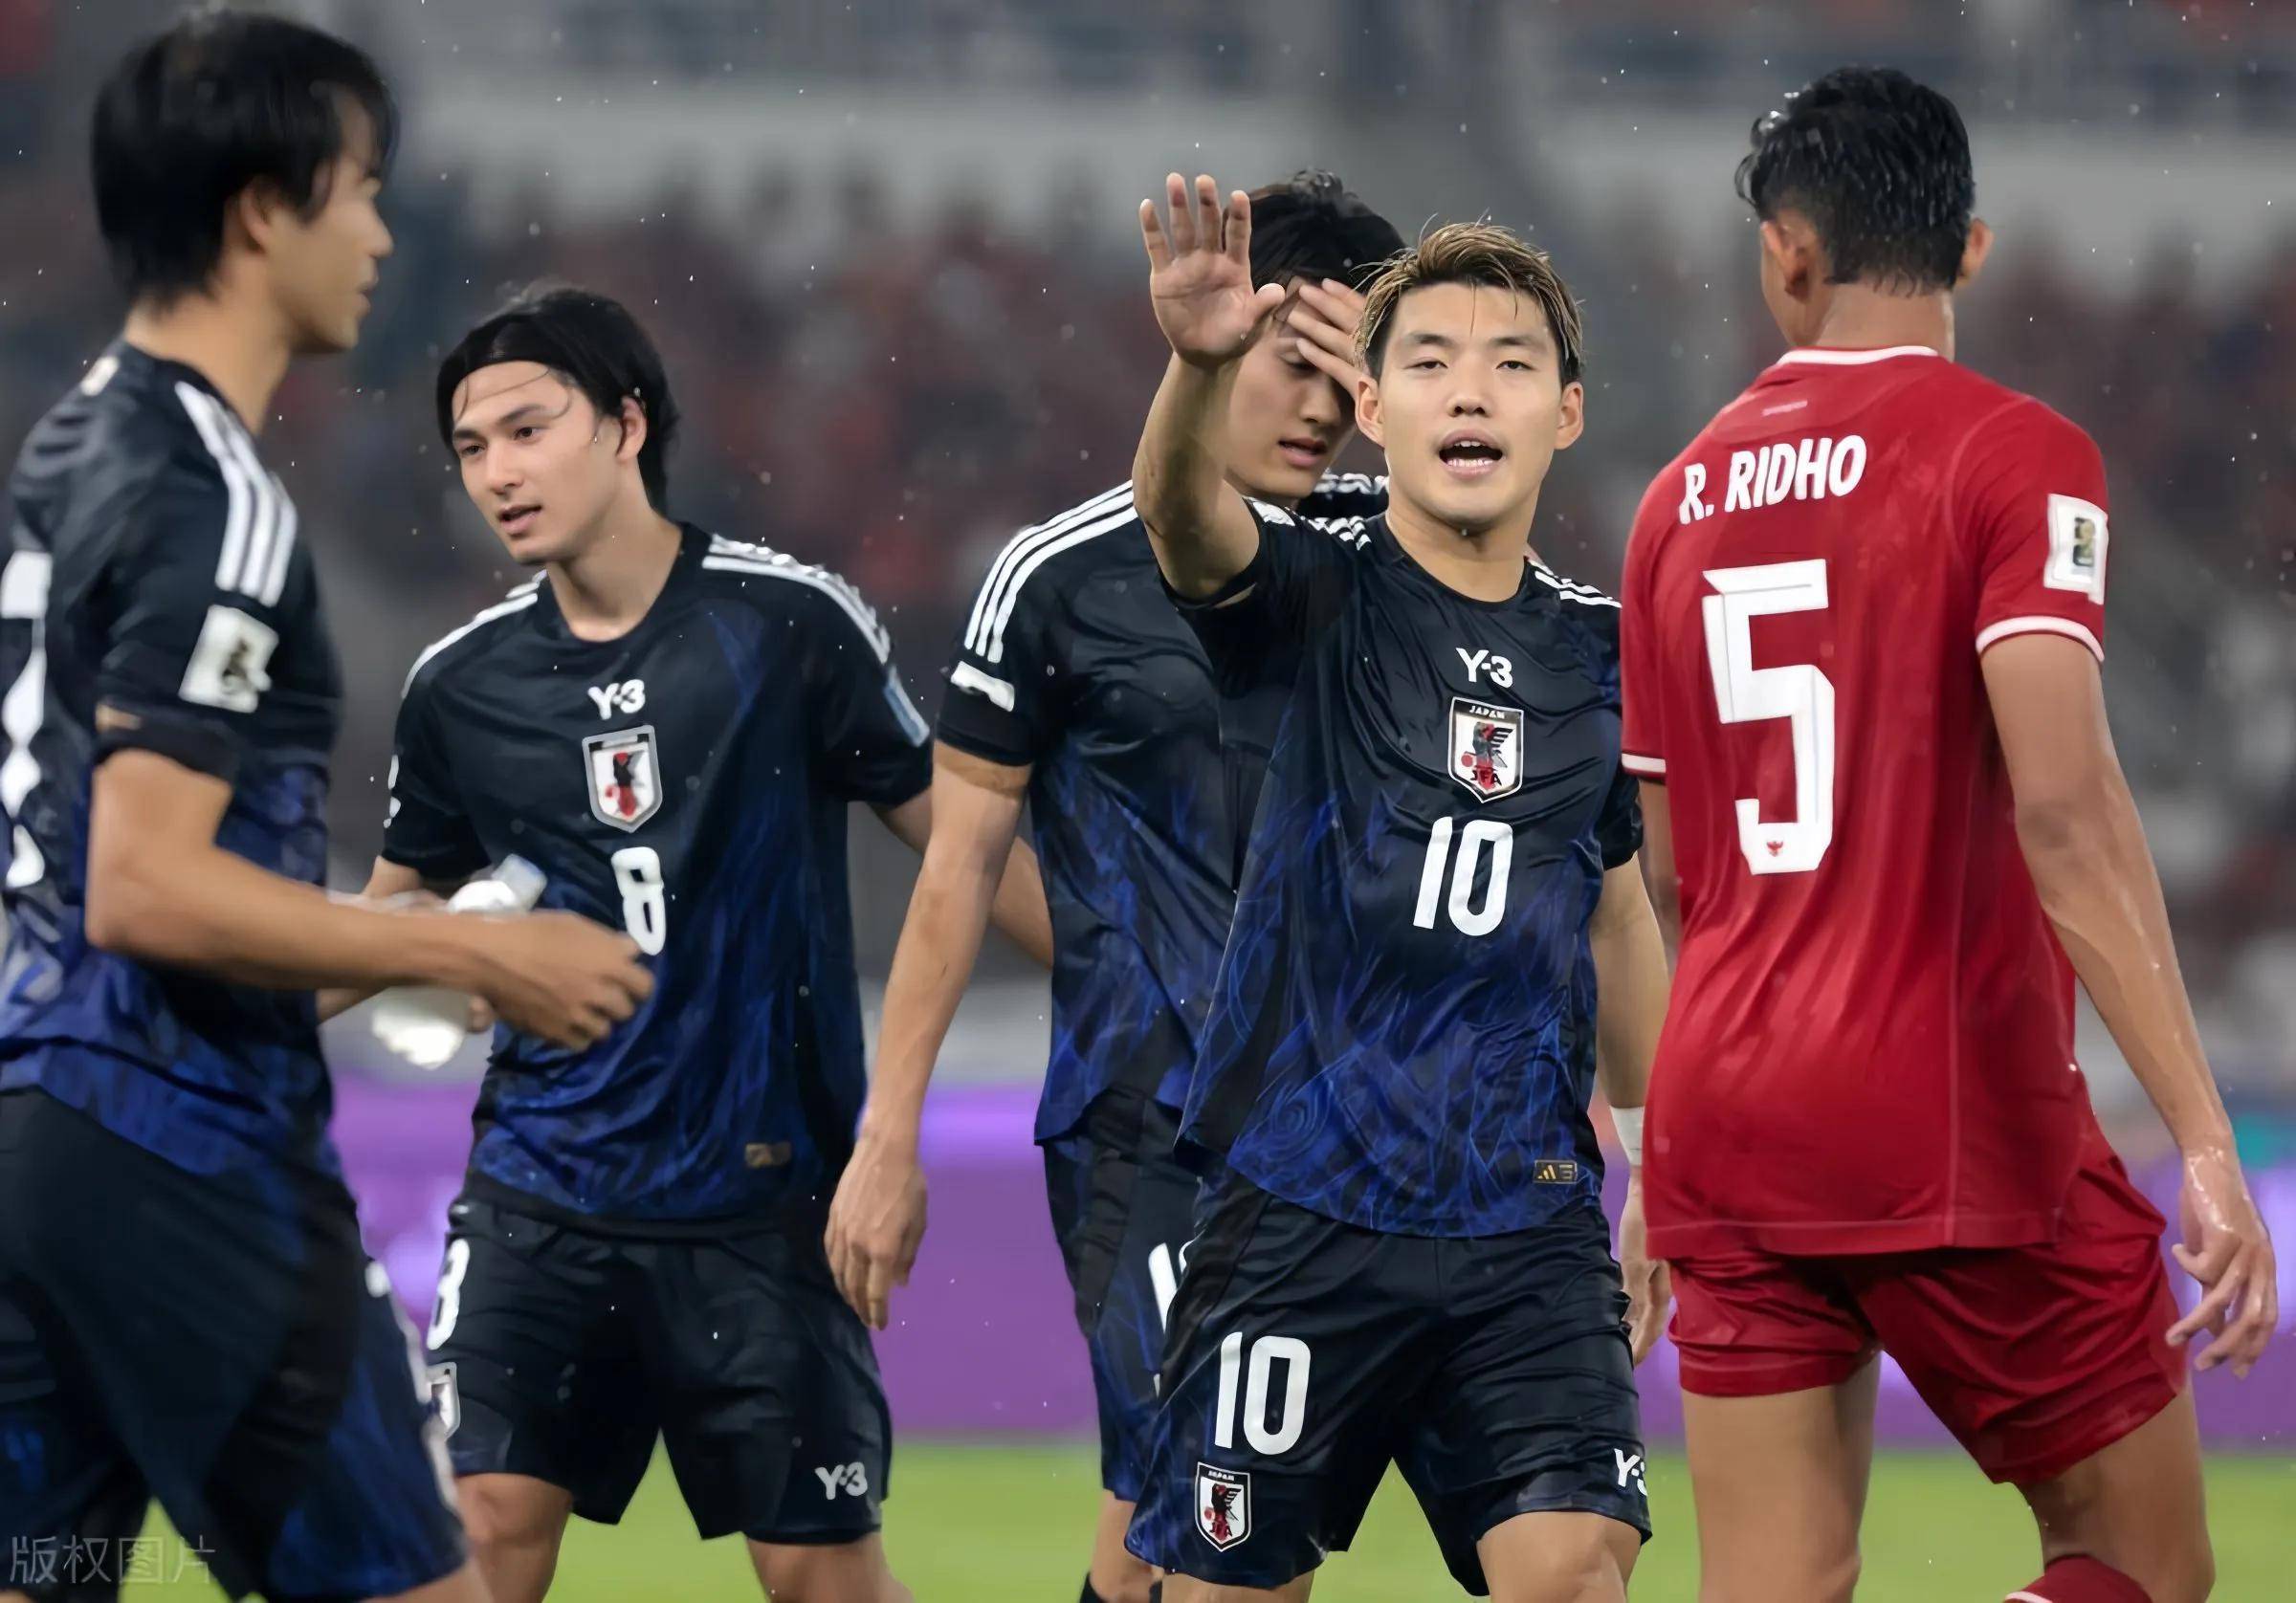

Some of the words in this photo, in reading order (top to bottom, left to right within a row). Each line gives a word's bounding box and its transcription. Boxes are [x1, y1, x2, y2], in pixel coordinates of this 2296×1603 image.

[1679, 463, 1714, 524] R.
[1725, 434, 1867, 513] RIDHO
[587, 678, 646, 720] Y-3
[1455, 647, 1513, 689] Y-3
[1468, 705, 1506, 719] JAPAN
[1701, 558, 1836, 876] 5
[611, 845, 667, 956] 8
[1412, 816, 1513, 937] 10
[1213, 1330, 1312, 1456] 10
[814, 1460, 869, 1501] Y-3
